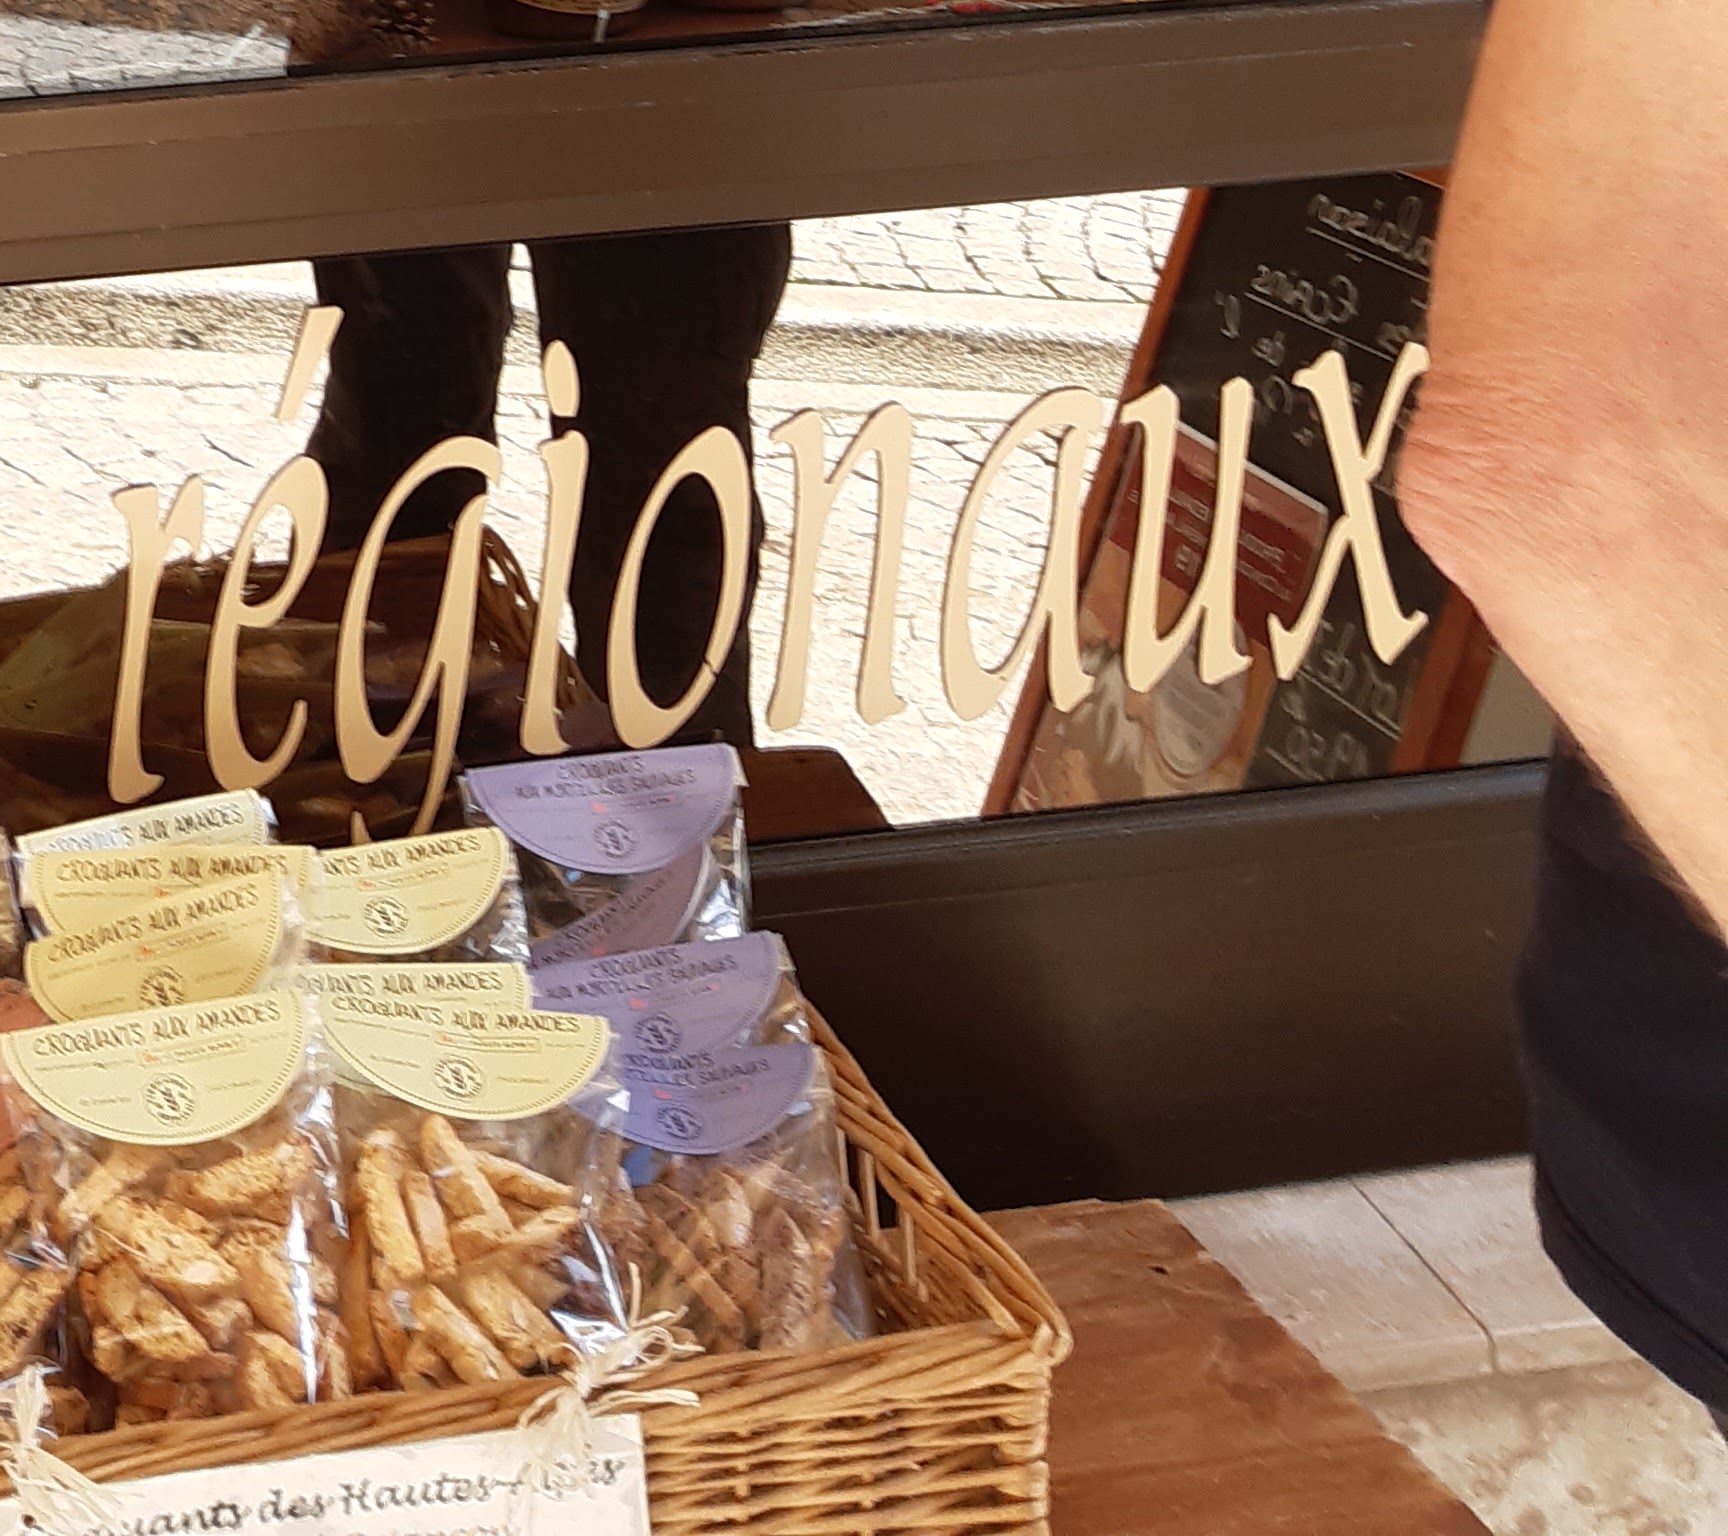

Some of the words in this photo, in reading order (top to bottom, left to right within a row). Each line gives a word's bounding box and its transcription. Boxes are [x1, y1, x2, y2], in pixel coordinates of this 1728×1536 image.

[106, 305, 1430, 846] régionaux
[174, 802, 246, 835] AMANDES
[55, 856, 163, 884] CROQUANTS
[169, 855, 204, 880] AUX
[207, 852, 290, 876] AMANDES
[367, 847, 402, 871] AUX
[405, 833, 482, 865] AMANDES
[47, 914, 144, 963] CROQUANTS
[148, 904, 183, 931] AUX
[185, 881, 261, 917] AMANDES
[381, 972, 417, 995] AUX
[423, 970, 504, 993] AMANDES
[31, 1021, 146, 1057] CROQUANTS
[151, 1014, 192, 1041] AUX
[195, 997, 282, 1035] AMANDES
[331, 996, 445, 1027] CROQUANTS
[451, 1011, 489, 1032] AUX
[495, 1012, 581, 1034] AMANDES
[258, 1487, 329, 1525] des
